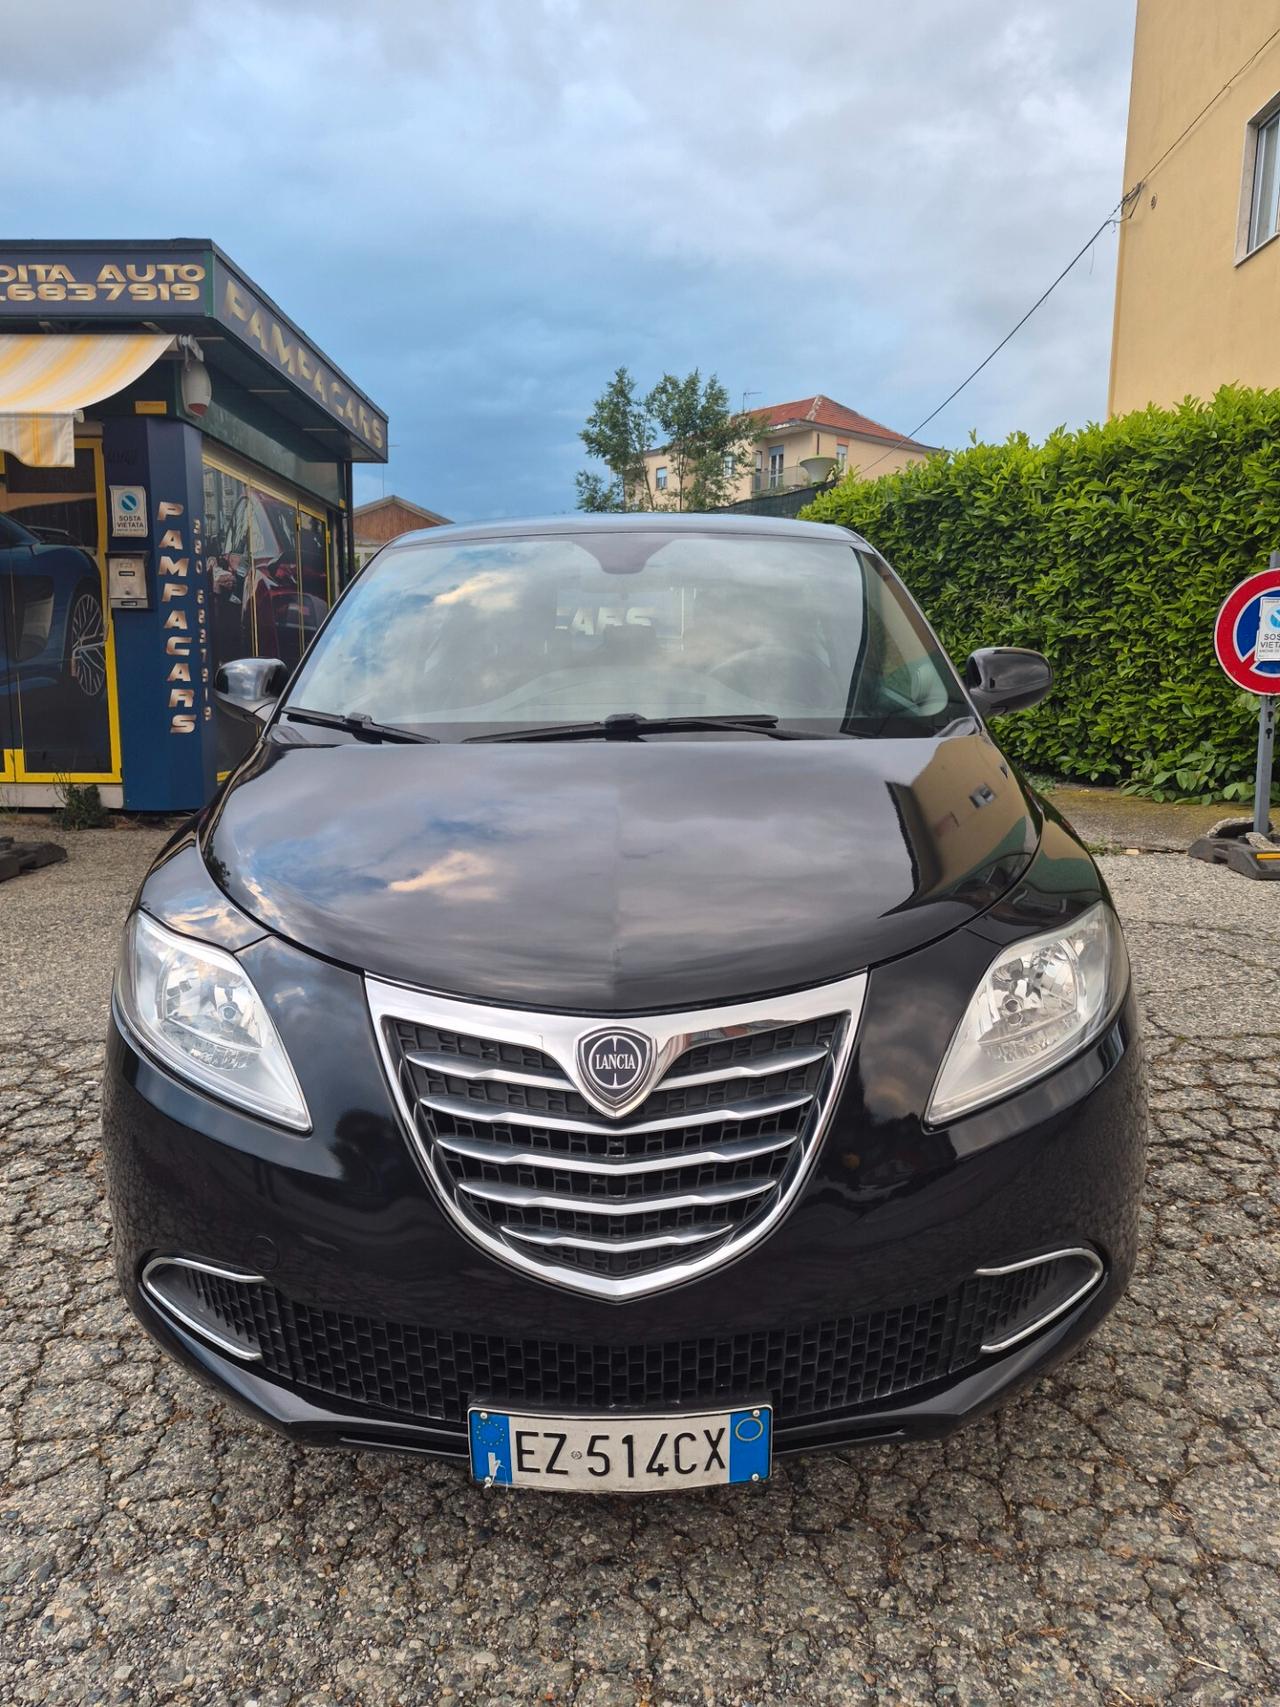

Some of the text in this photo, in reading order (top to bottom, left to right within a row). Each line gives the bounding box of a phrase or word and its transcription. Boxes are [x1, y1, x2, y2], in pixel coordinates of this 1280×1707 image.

[96, 264, 206, 283] AUTO
[157, 501, 197, 734] PAMPACARS
[595, 1053, 636, 1070] LANCIA
[515, 1428, 726, 1478] EZ 514CX
